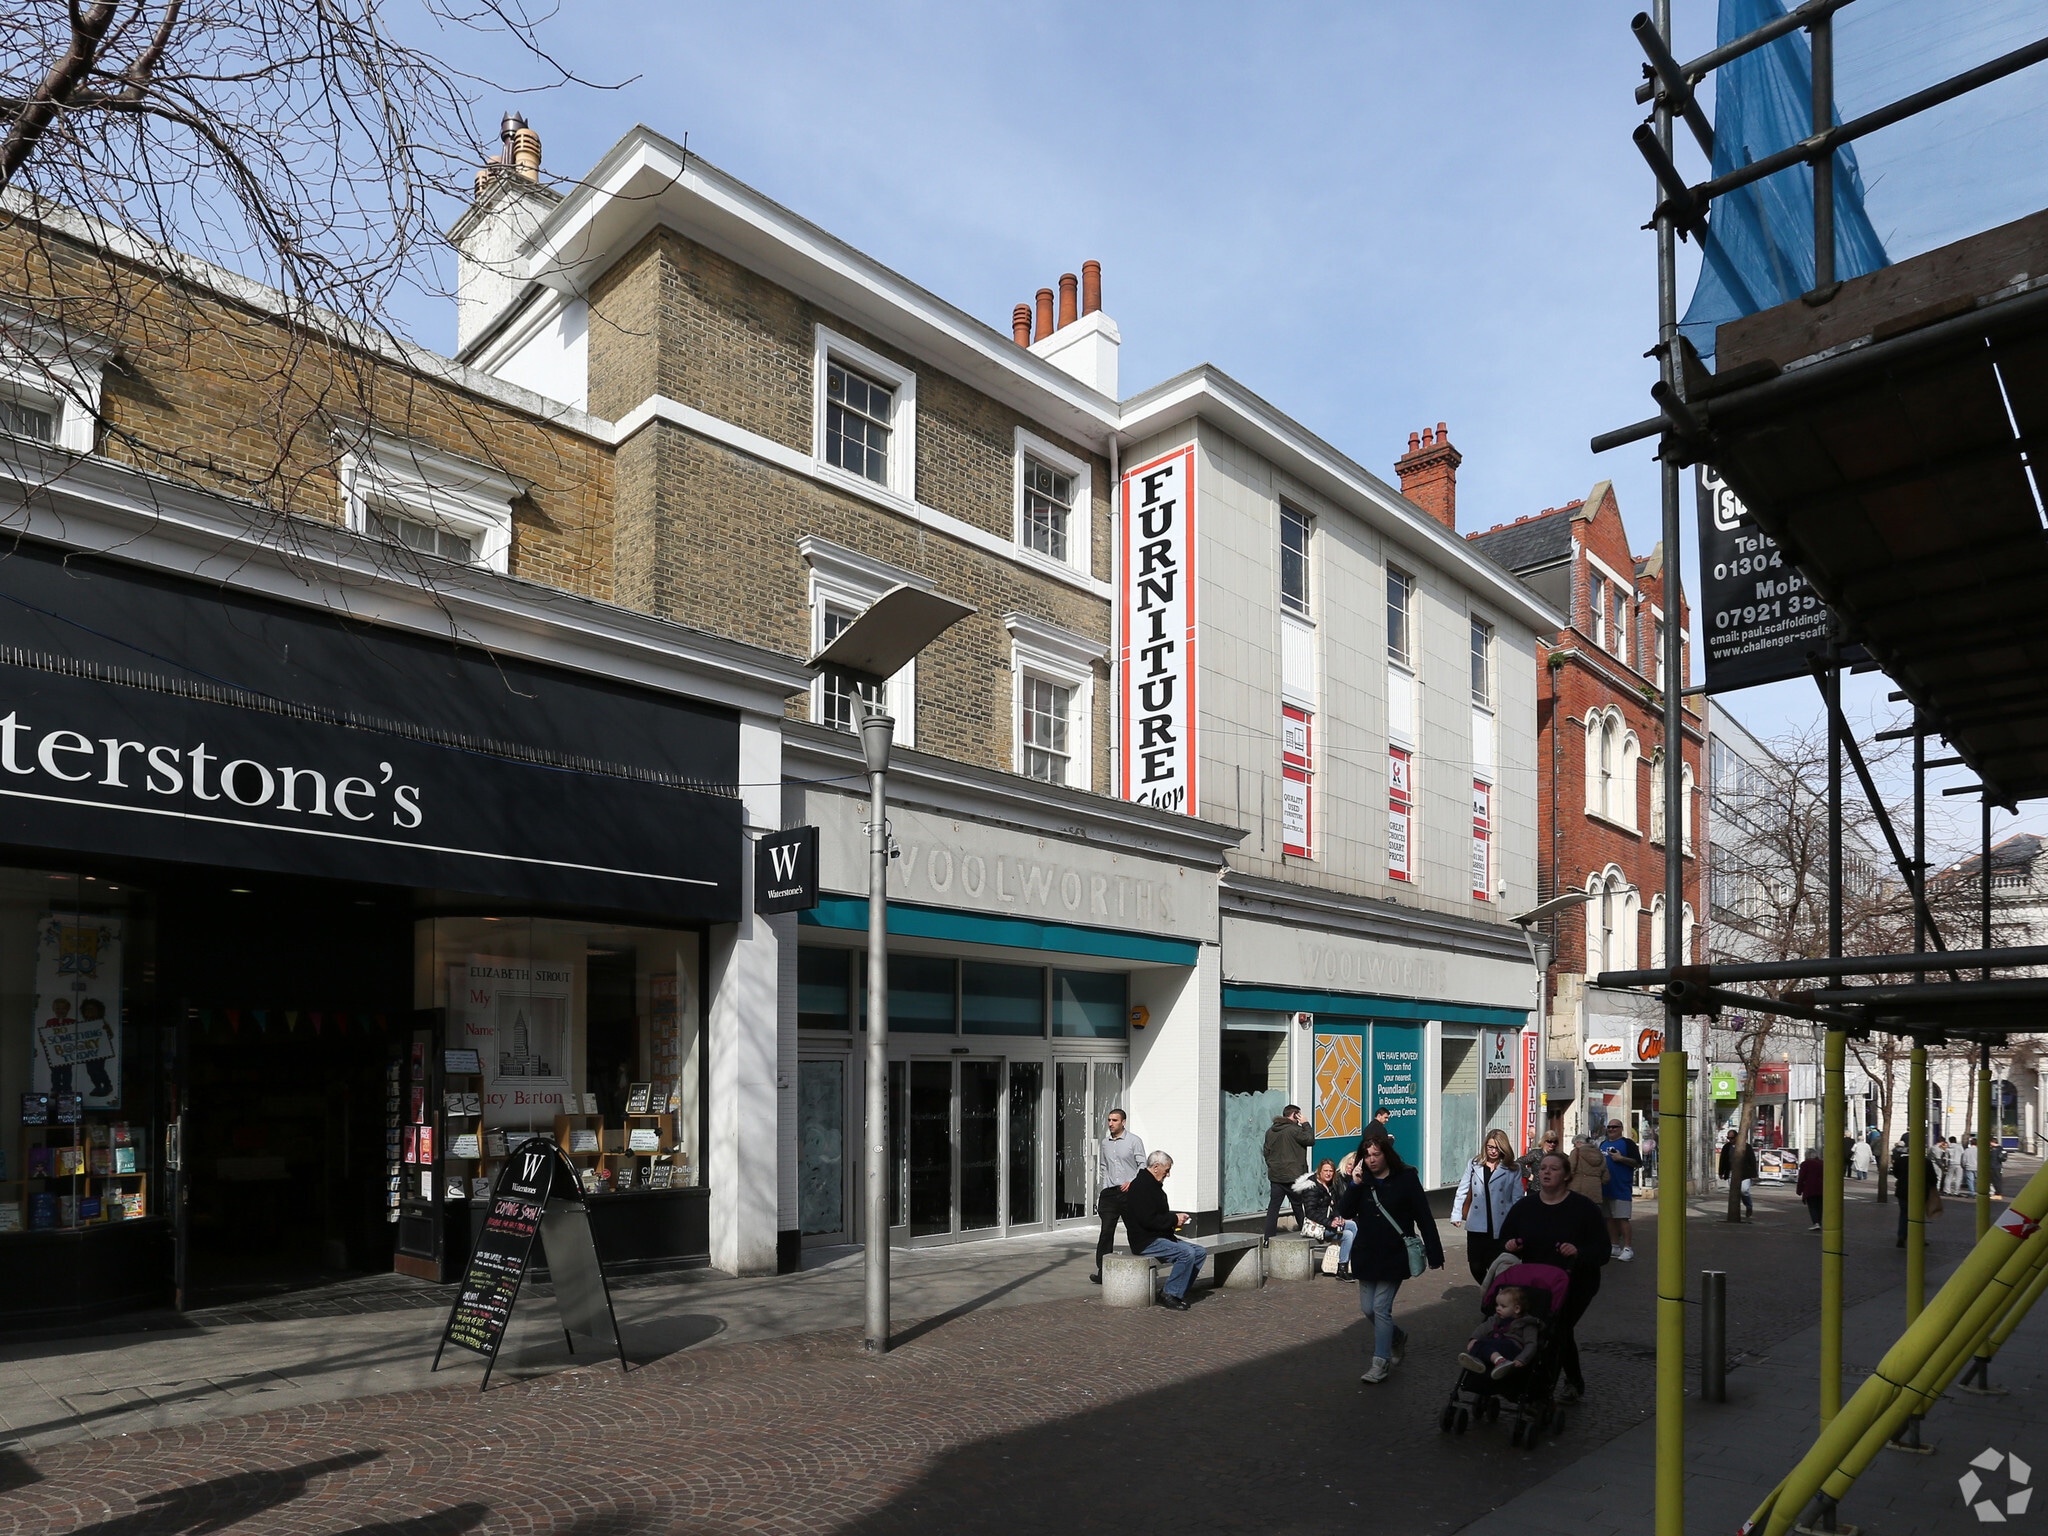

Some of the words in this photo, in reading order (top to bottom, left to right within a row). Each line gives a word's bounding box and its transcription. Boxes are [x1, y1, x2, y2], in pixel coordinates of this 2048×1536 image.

[1713, 550, 1783, 581] 01304
[1715, 600, 1781, 629] 07921
[1788, 595, 1826, 614] 35
[1137, 465, 1178, 784] FURNITURE
[1710, 631, 1740, 646] email:
[1741, 609, 1828, 643] paul.scaffolding@
[1712, 624, 1829, 659] www.challenger-scaff
[1284, 793, 1304, 805] QUALITY
[1287, 803, 1300, 813] USED
[1389, 821, 1404, 833] GREAT
[1388, 841, 1405, 852] SMART
[768, 842, 802, 883] W
[1388, 851, 1405, 863] PRICES
[767, 885, 803, 899] Waterstone's
[470, 966, 530, 981] ELIZABETH
[535, 970, 571, 982] STROUT
[470, 989, 491, 1009] My
[466, 1023, 494, 1036] Name
[1376, 1051, 1385, 1060] WE
[1385, 1051, 1399, 1060] HAVE
[1399, 1051, 1419, 1061] MOVED!
[1383, 1062, 1393, 1071] You
[1402, 1062, 1412, 1071] find
[1488, 1062, 1511, 1074] ReBorn
[1383, 1075, 1394, 1083] your
[1377, 1083, 1409, 1095] Poundland
[484, 1093, 508, 1109] ucy
[514, 1090, 564, 1106] Barton
[1378, 1097, 1384, 1105] in
[1384, 1097, 1404, 1105] Bouverie
[1405, 1096, 1417, 1104] Place
[1401, 1107, 1417, 1116] Centre
[522, 1152, 546, 1182] W
[511, 1182, 537, 1195] Waterstones
[495, 1200, 520, 1216] COMING
